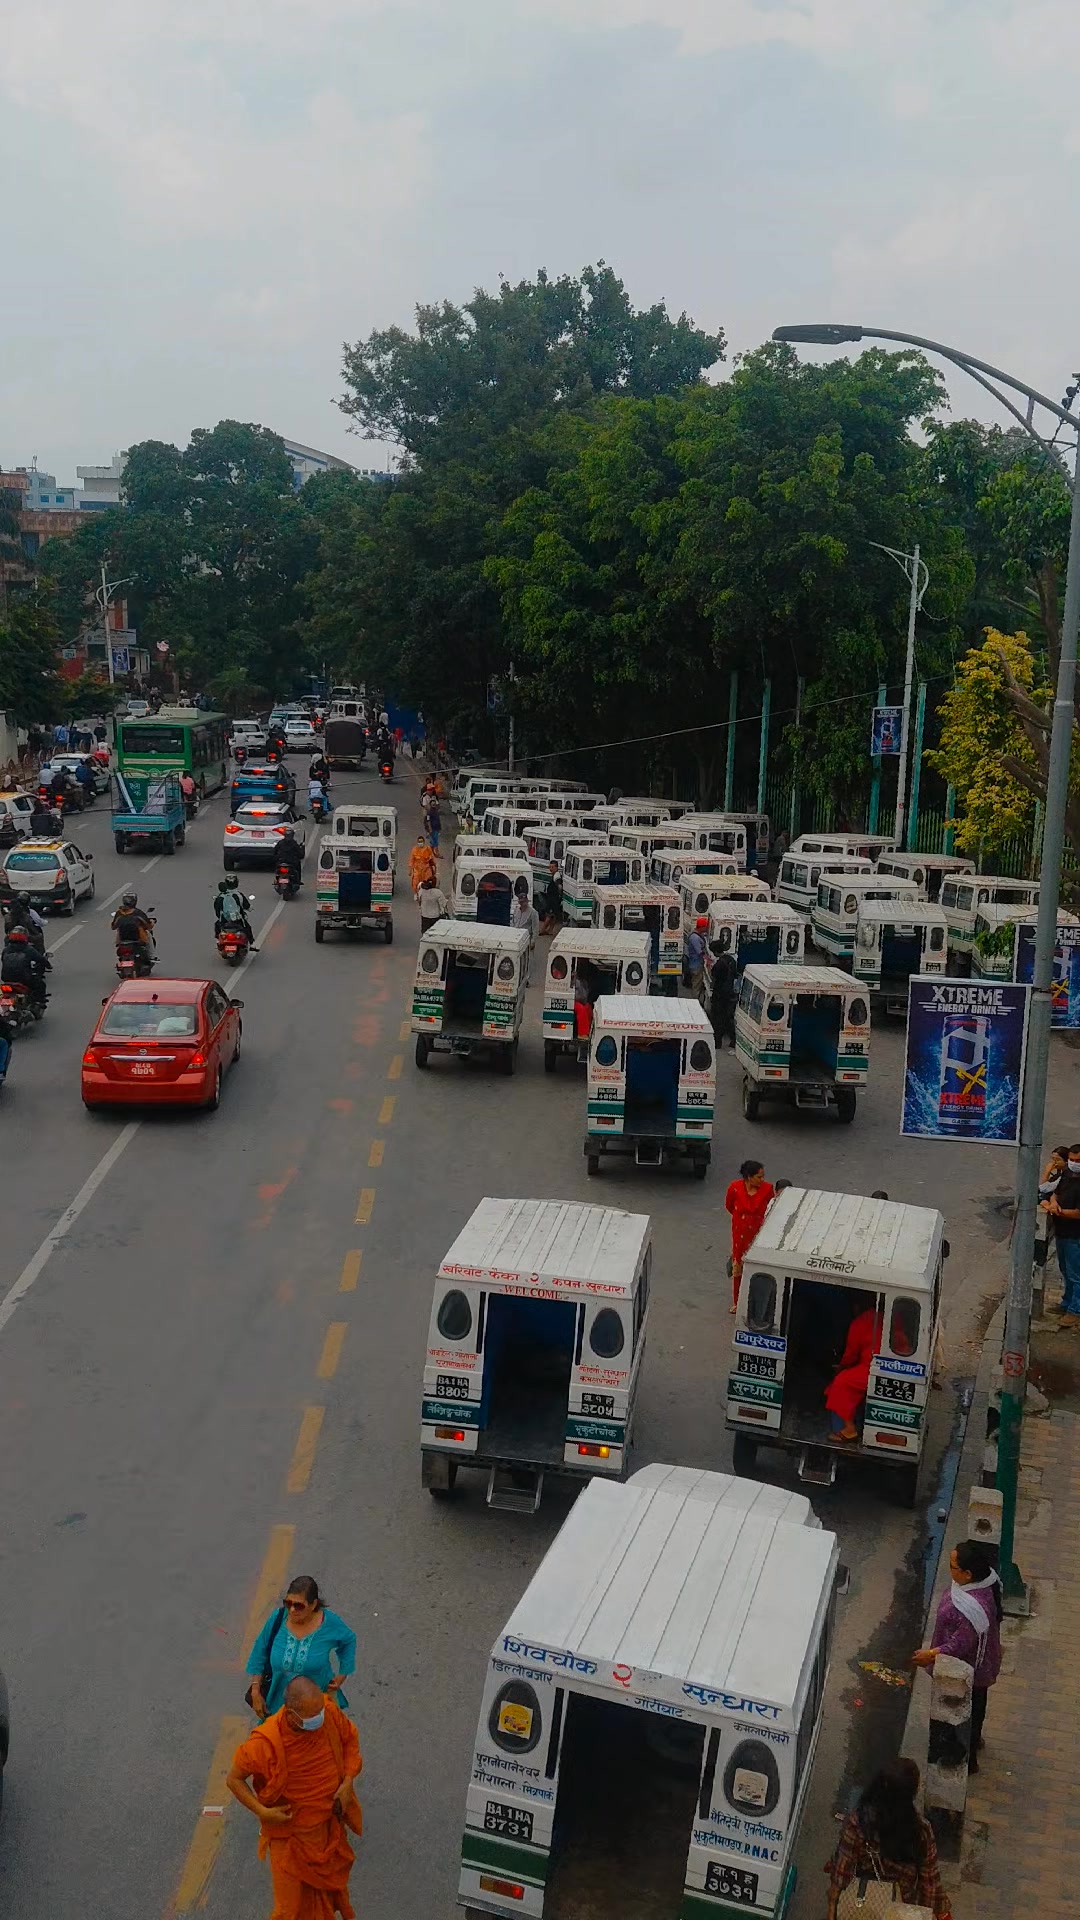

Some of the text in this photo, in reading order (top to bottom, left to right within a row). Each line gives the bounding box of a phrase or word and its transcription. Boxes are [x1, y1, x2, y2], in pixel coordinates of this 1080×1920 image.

[932, 986, 1003, 1005] XTREME
[937, 1003, 996, 1014] ENERGY DRINK
[806, 1257, 856, 1273] कालिमाटी
[504, 1285, 562, 1300] WELCOME
[736, 1331, 785, 1349] त्रिपुरेश्वर
[740, 1362, 775, 1376] 3896
[437, 1386, 469, 1399] 3805
[733, 1382, 775, 1399] सुन्धारा
[871, 1408, 915, 1423] रत्नपार्क
[613, 1663, 633, 1688] २
[682, 1682, 782, 1720] सुन्धारा
[486, 1816, 530, 1838] 3731
[708, 1878, 753, 1901] ३७३१
